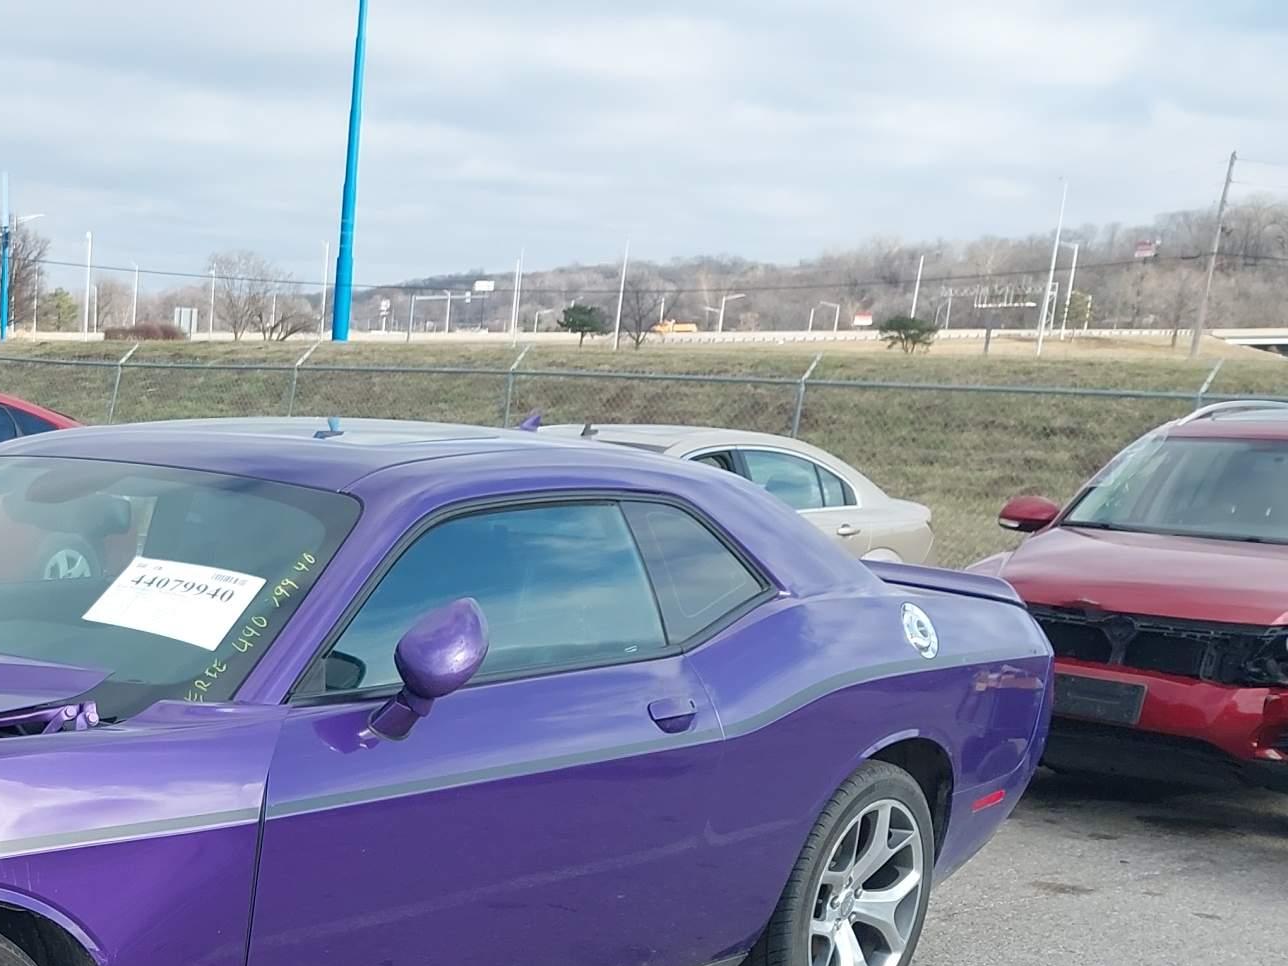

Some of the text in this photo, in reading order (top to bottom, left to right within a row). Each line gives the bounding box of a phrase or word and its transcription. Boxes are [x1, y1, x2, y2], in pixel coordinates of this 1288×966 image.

[130, 574, 235, 602] 44079940
[231, 616, 268, 653] 440
[293, 552, 316, 571] 40
